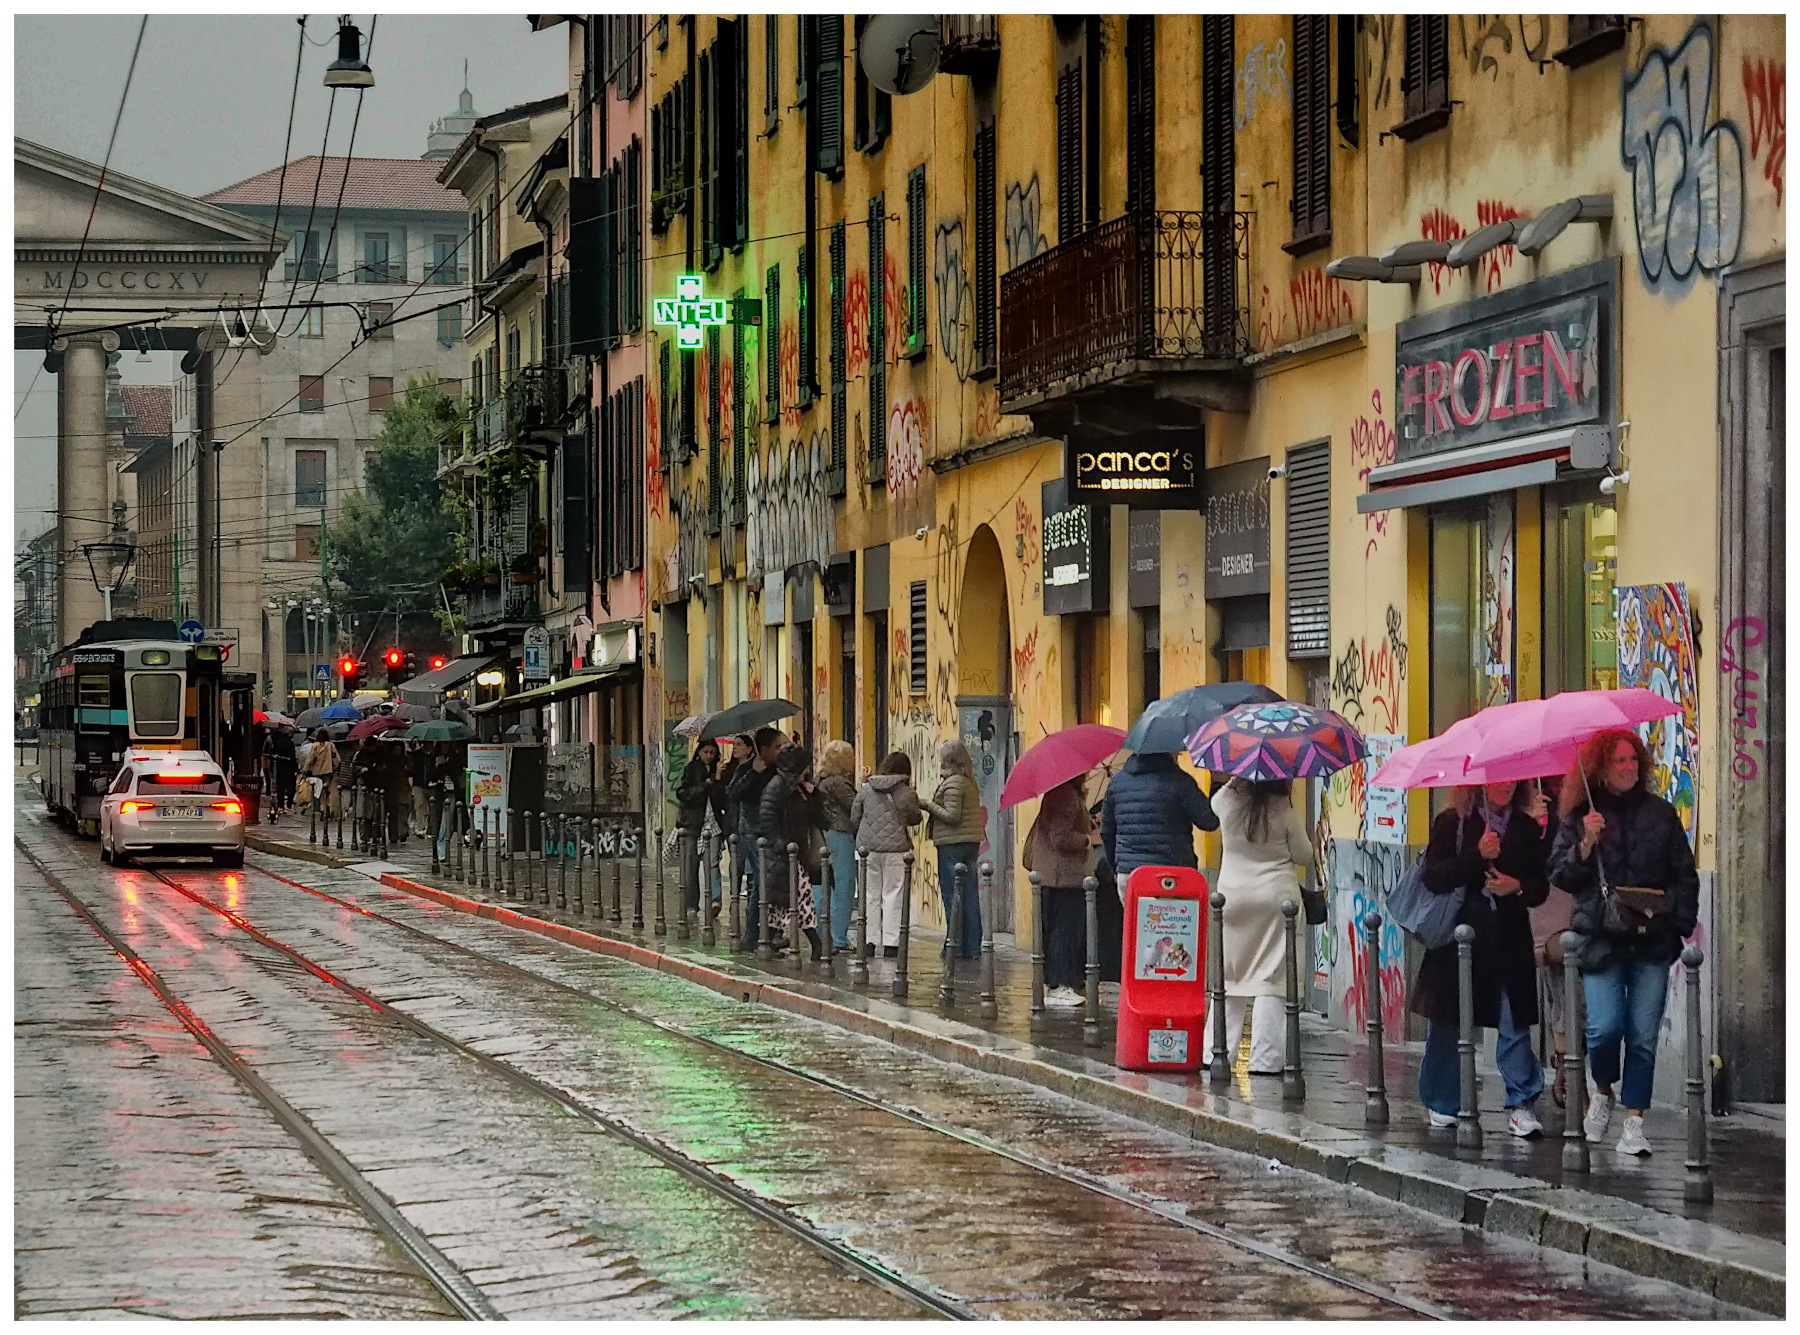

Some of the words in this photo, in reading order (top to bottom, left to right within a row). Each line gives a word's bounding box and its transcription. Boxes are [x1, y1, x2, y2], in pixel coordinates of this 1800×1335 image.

[44, 271, 209, 289] MDCCCXV
[1404, 330, 1581, 434] FROZEN
[1077, 448, 1193, 478] panca's
[1101, 478, 1170, 490] DESIGNER
[1221, 553, 1254, 576] DESIGNER
